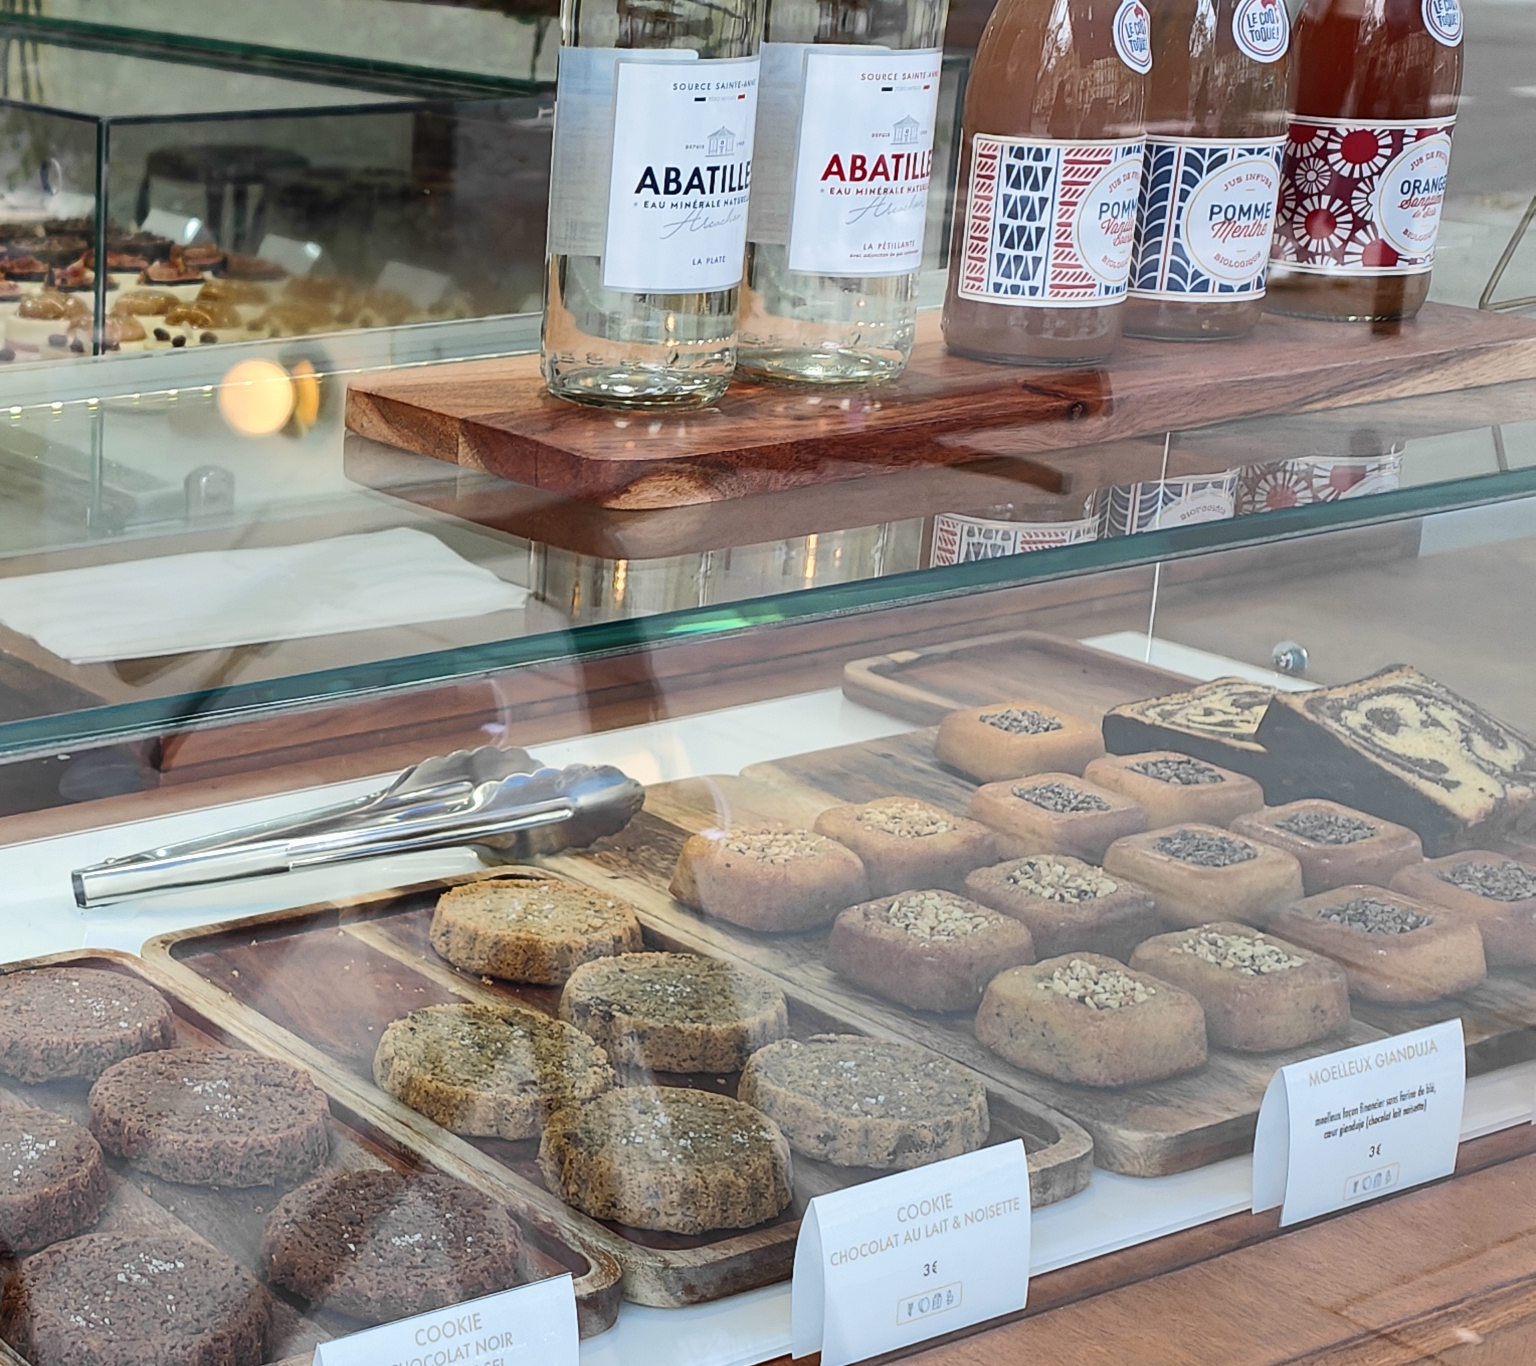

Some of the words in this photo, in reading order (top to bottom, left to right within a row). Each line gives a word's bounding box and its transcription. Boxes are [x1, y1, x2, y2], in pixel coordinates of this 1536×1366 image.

[1433, 0, 1443, 14] LE
[1247, 12, 1258, 28] LE
[1125, 21, 1134, 38] LE
[860, 73, 898, 81] SOURCE
[673, 82, 711, 91] SOURCE
[1410, 156, 1424, 171] JUS
[830, 187, 851, 195] EAU
[855, 186, 904, 195] MINÉRALE
[1224, 176, 1242, 192] JUS
[644, 201, 666, 209] EAU
[670, 199, 721, 209] MINÉRALE
[1209, 201, 1272, 221] POMME
[1211, 219, 1267, 244] Menthe
[692, 258, 702, 266] LA
[706, 255, 726, 265] PLATE
[1308, 1056, 1373, 1086] MOELLEUX
[1375, 1039, 1438, 1068] GIANDUJA
[1417, 1085, 1425, 1096] de
[1369, 1143, 1382, 1158] 3€
[897, 1193, 953, 1223] COOKIE
[830, 1233, 900, 1267] CHOCOLAT
[903, 1227, 921, 1245] AU
[925, 1218, 948, 1238] LAIT
[952, 1216, 961, 1229] &
[964, 1197, 1020, 1227] NOISETTE
[923, 1260, 938, 1277] 3€
[415, 1312, 483, 1346] COOKIE
[475, 1331, 514, 1352] NOIR
